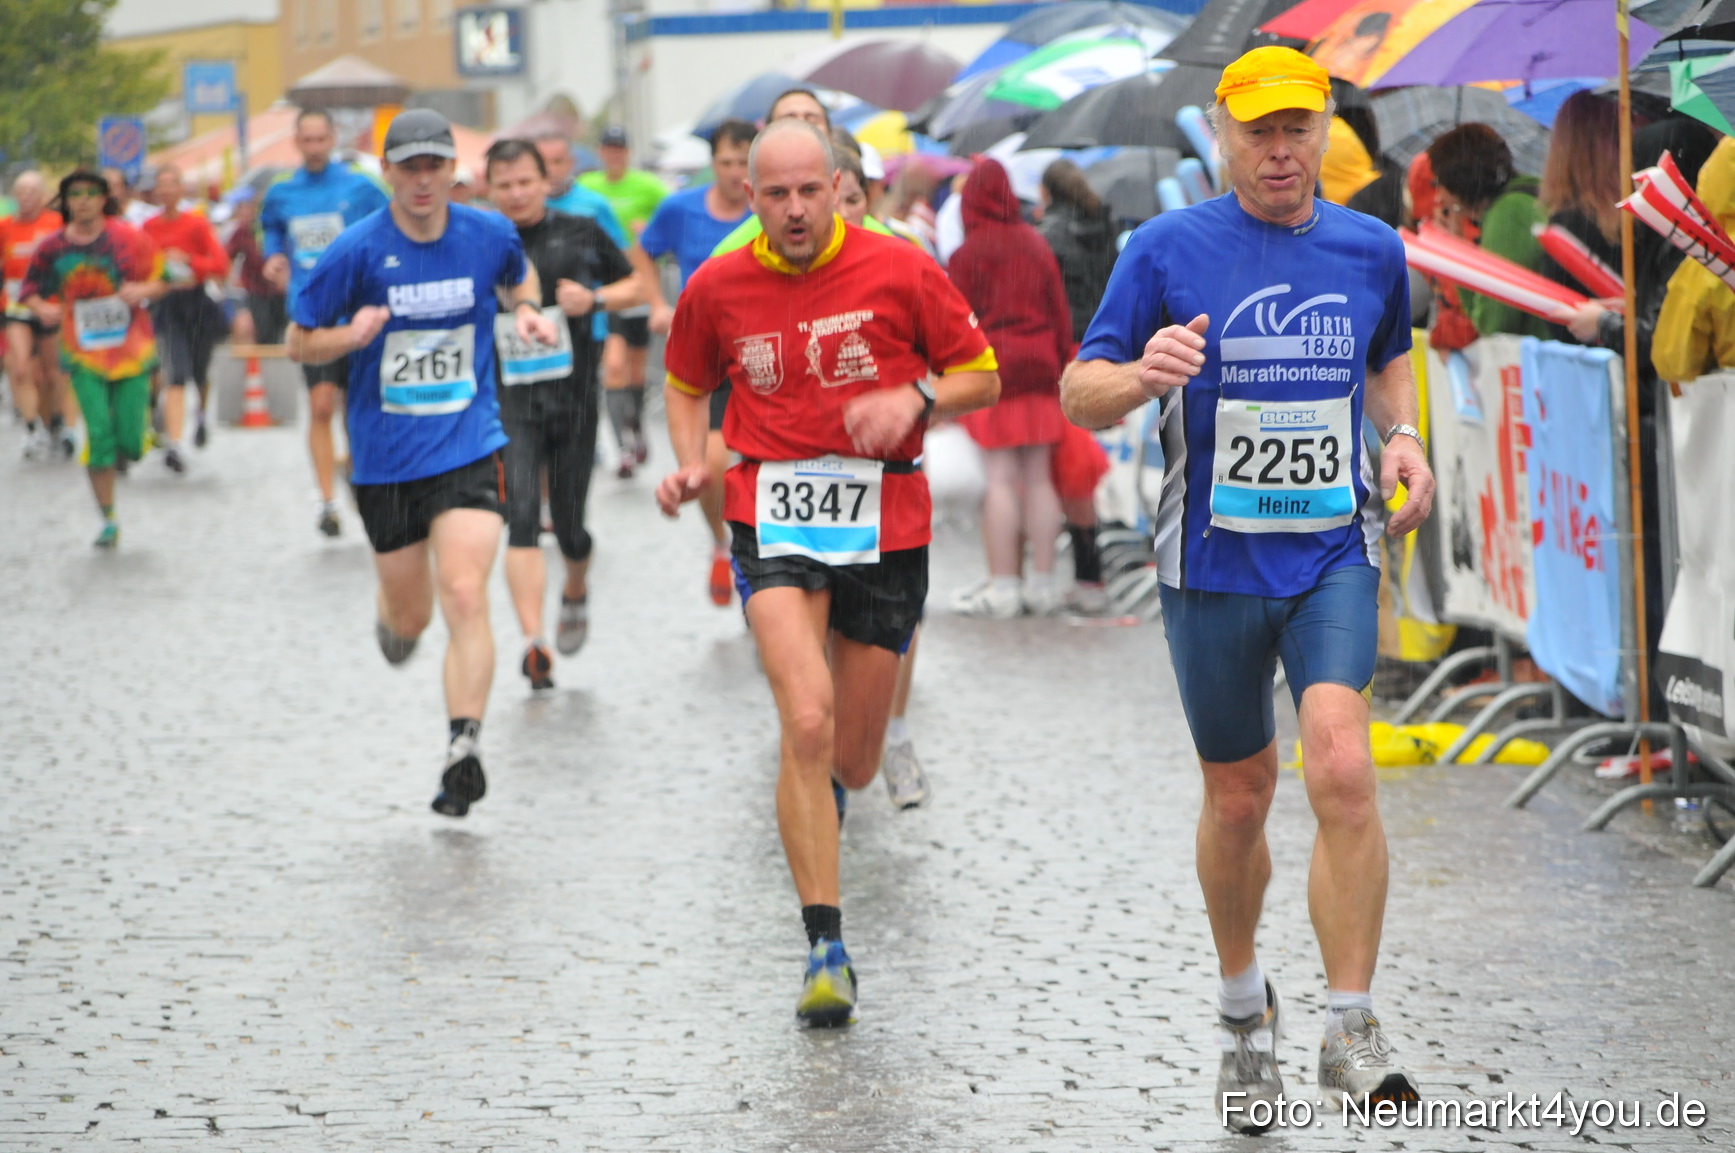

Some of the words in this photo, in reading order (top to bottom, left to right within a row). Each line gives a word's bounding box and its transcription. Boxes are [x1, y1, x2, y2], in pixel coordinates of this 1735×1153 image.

[388, 277, 475, 303] HUBER
[1300, 311, 1352, 336] FÜRTH
[1301, 338, 1351, 357] 1860
[393, 350, 465, 382] 2161
[1221, 364, 1351, 383] Marathonteam
[1260, 410, 1316, 424] BOCK
[1229, 436, 1340, 485] 2253
[770, 482, 868, 522] 3347
[1258, 496, 1310, 514] Heinz
